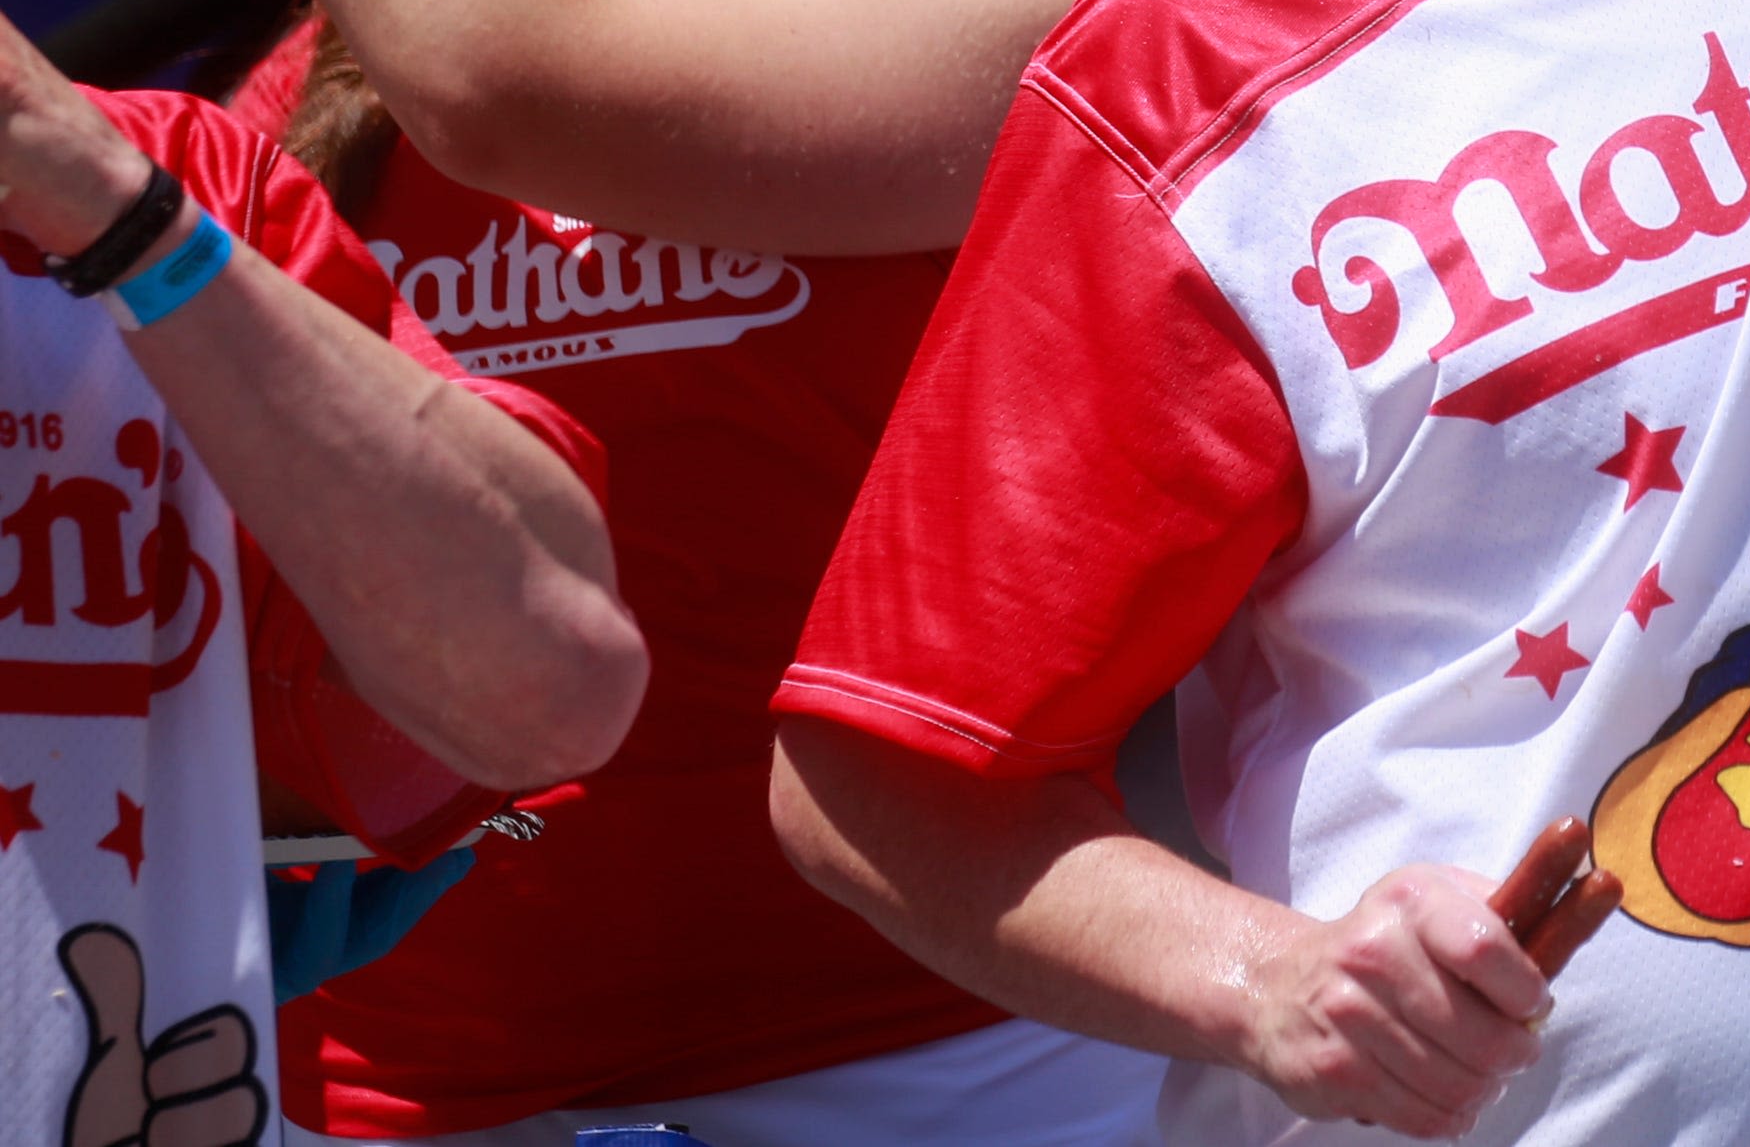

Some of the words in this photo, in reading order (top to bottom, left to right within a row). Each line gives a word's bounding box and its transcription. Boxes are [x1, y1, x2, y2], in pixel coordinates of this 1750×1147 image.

[552, 213, 593, 234] Sin
[366, 212, 787, 337] athans
[468, 336, 617, 370] AMOUS
[0, 411, 64, 452] 916
